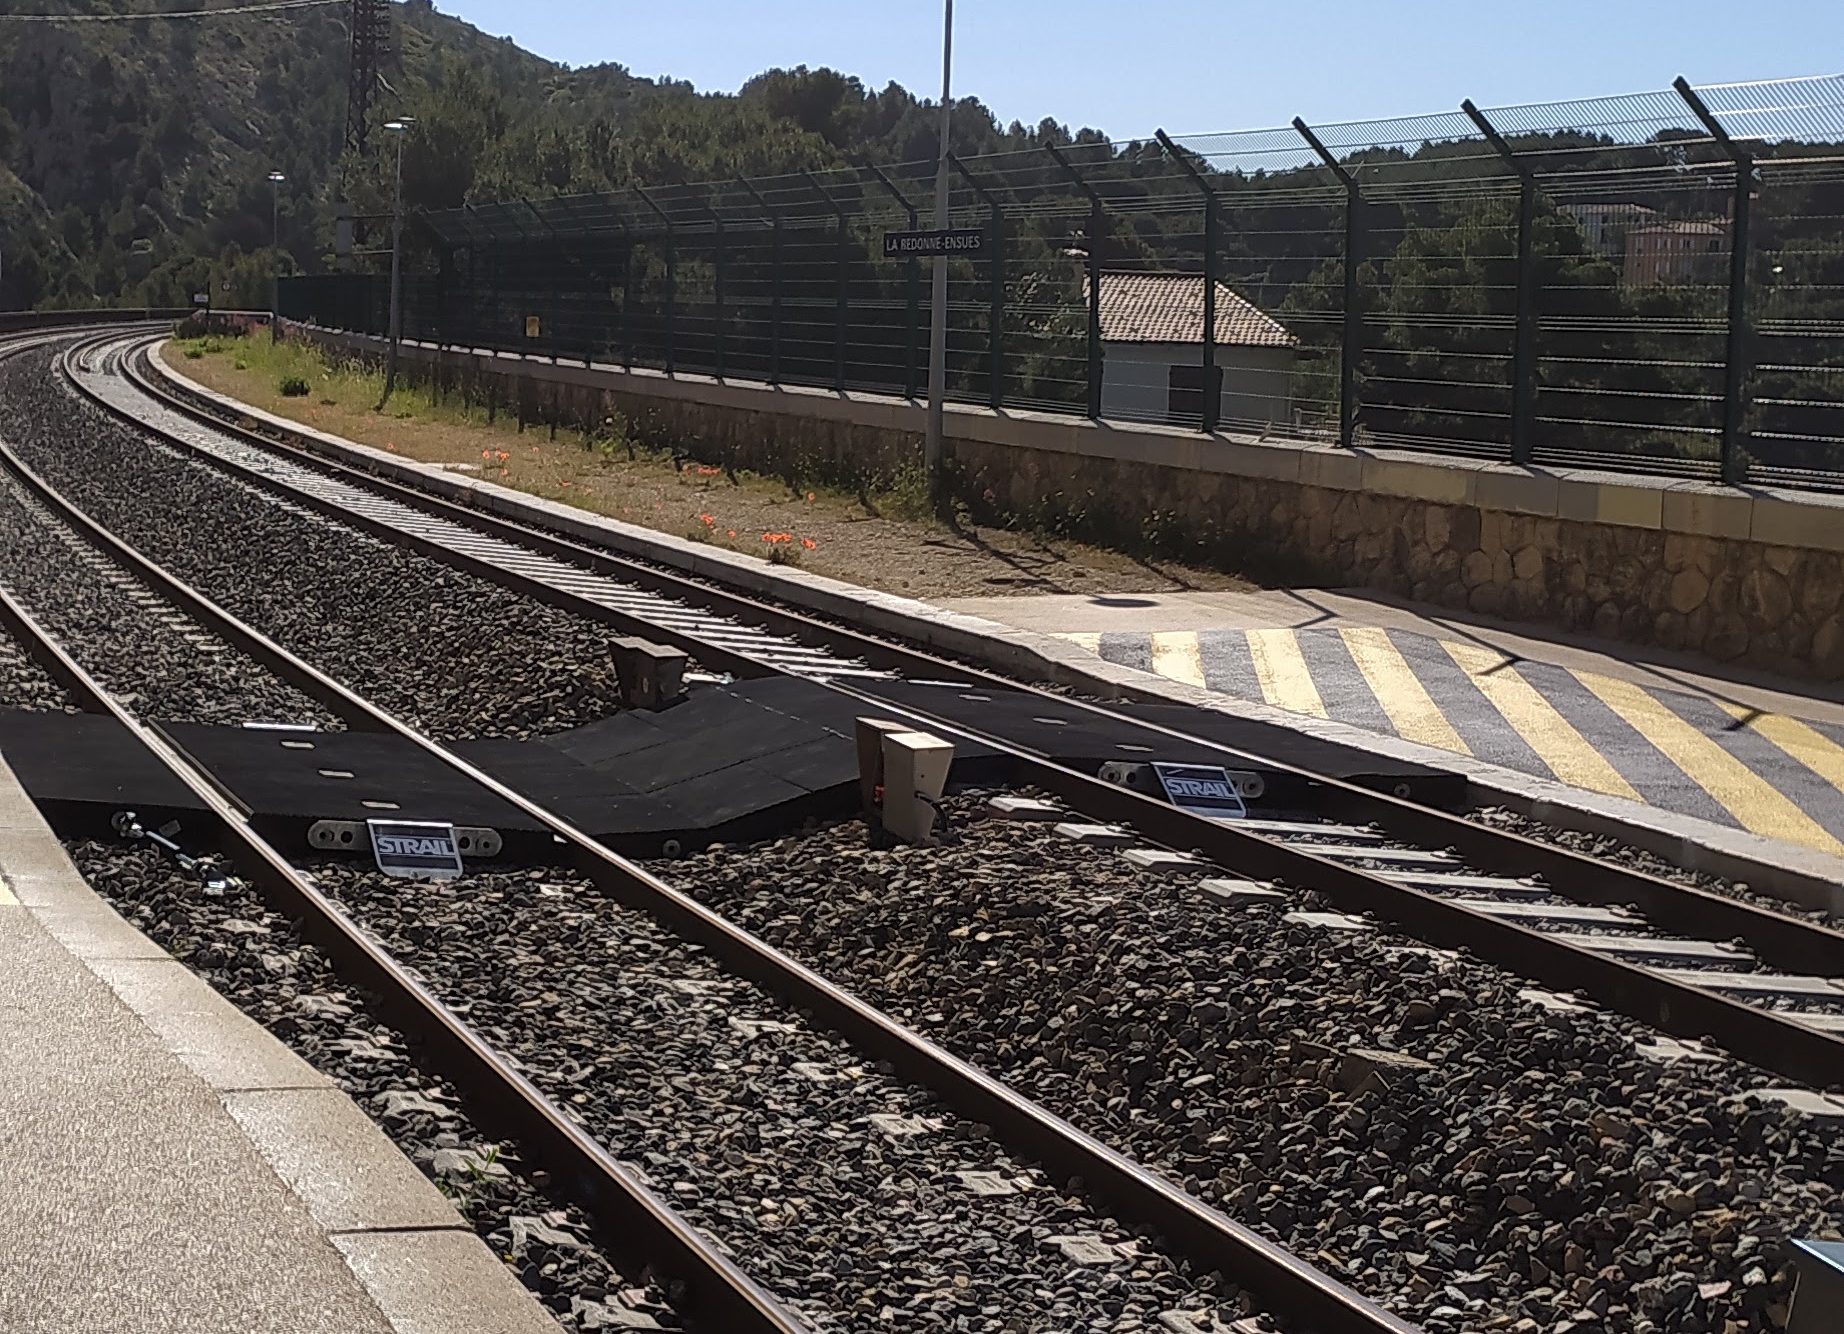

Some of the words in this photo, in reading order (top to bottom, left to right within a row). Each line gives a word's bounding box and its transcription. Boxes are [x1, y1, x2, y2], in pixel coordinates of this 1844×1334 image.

[886, 238, 898, 251] LA
[1167, 778, 1236, 798] STRAIL
[378, 837, 455, 856] STRAIL
